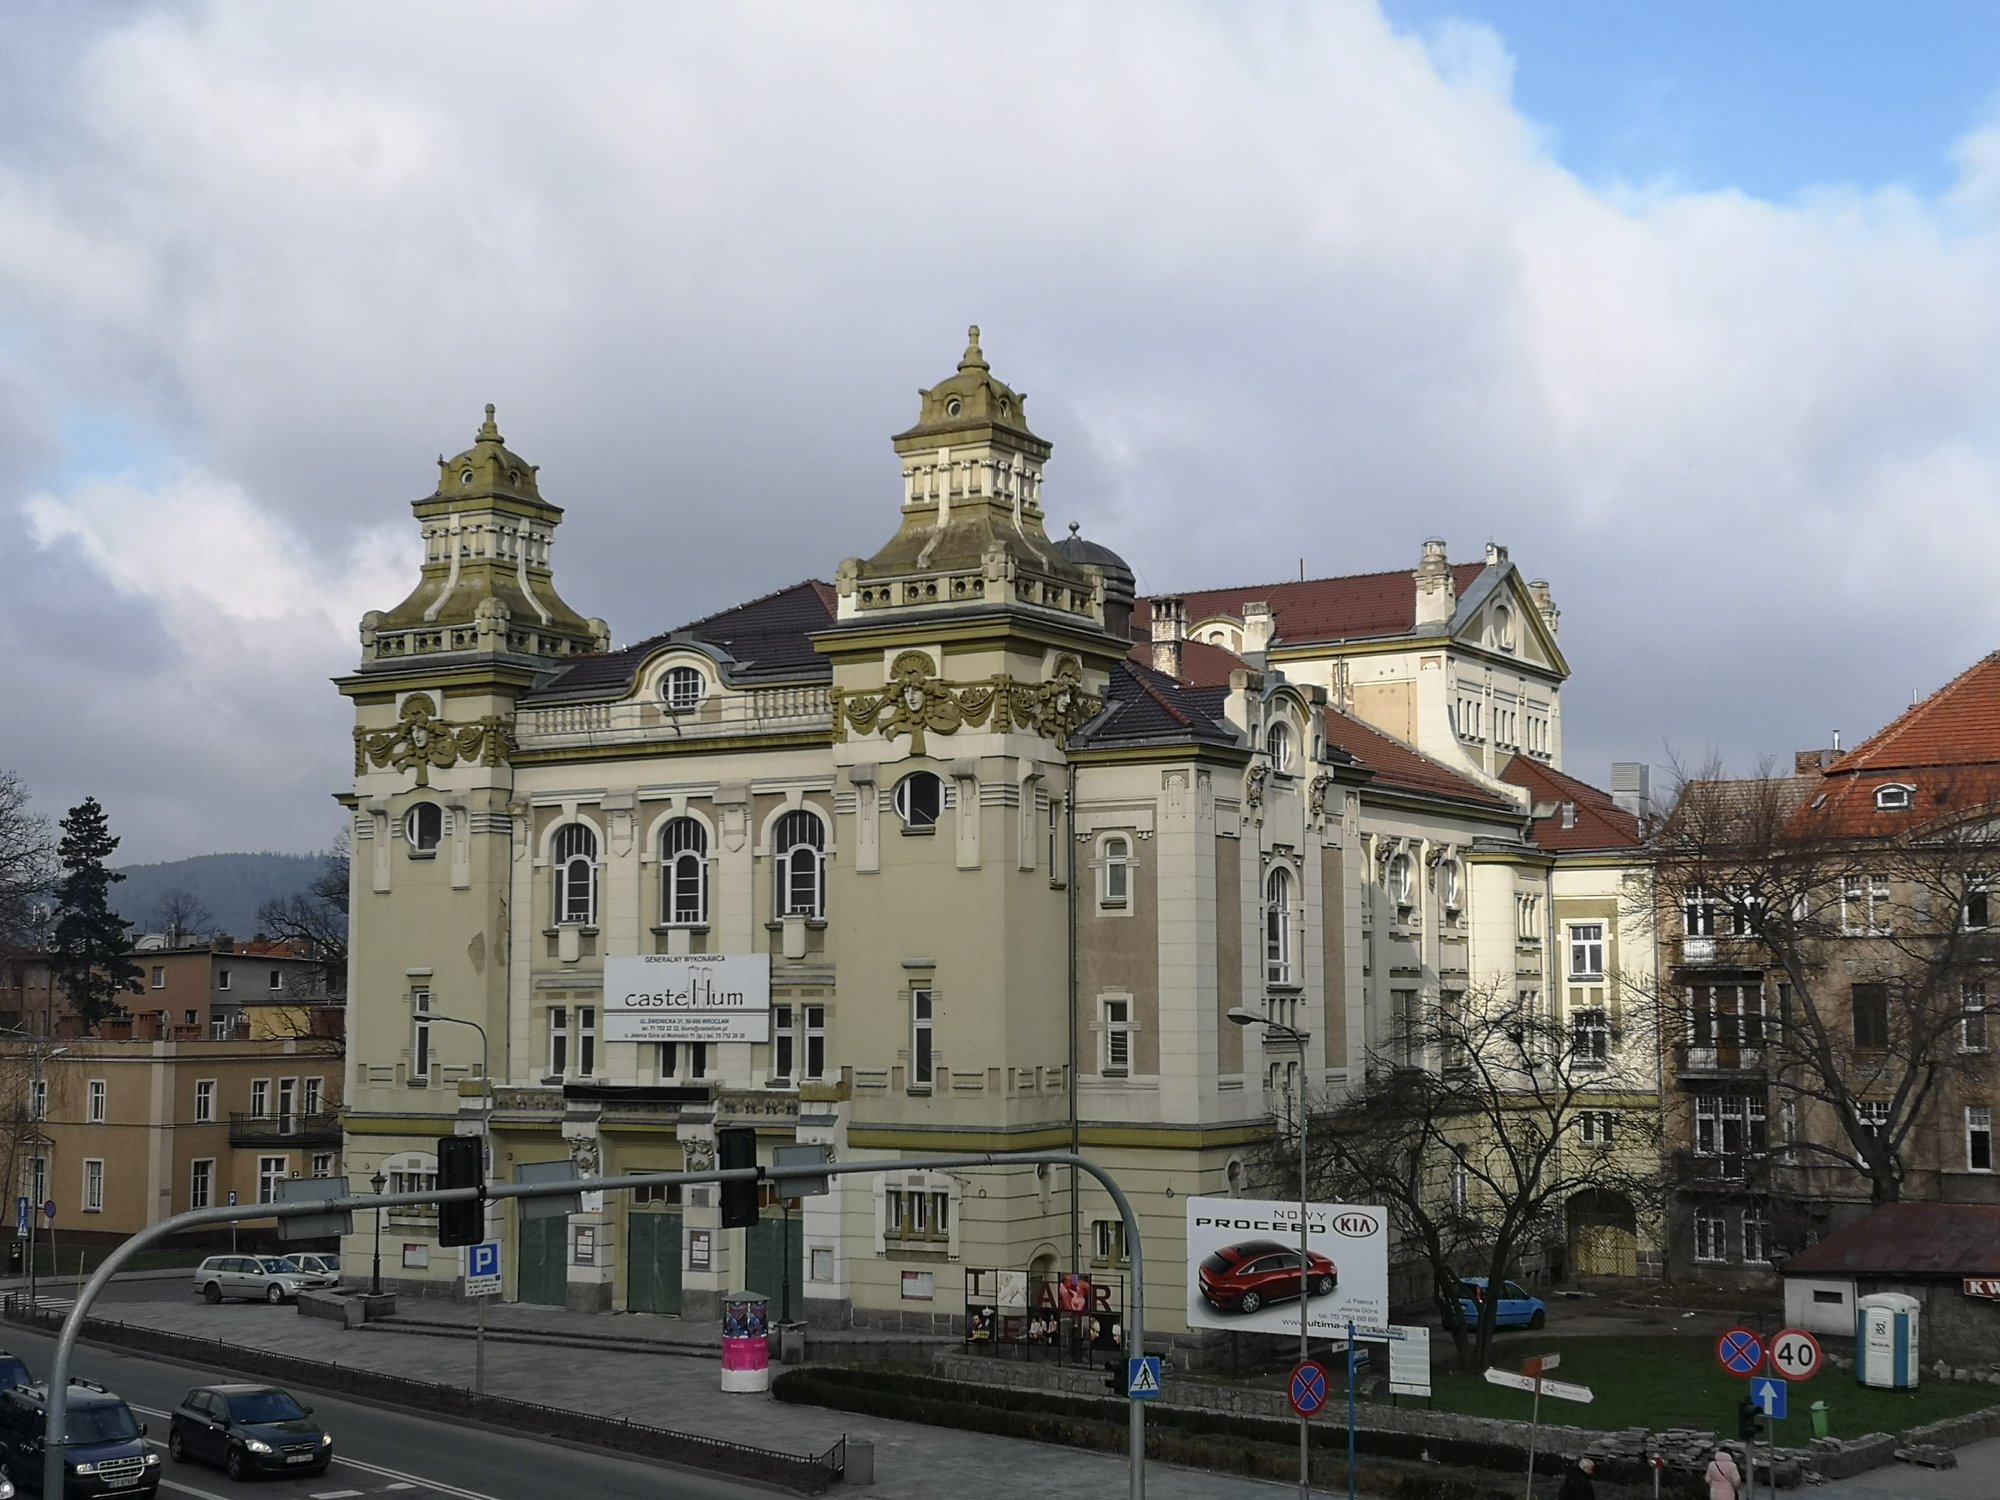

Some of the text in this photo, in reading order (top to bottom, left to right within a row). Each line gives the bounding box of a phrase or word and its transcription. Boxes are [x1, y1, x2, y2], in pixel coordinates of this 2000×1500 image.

[645, 955, 682, 963] GENERALNY
[625, 978, 743, 1007] castellum
[1274, 1210, 1327, 1221] NOWY
[1196, 1218, 1326, 1234] PROCEED
[1340, 1218, 1371, 1233] KIA
[476, 1247, 492, 1273] P
[1778, 1342, 1813, 1366] 40
